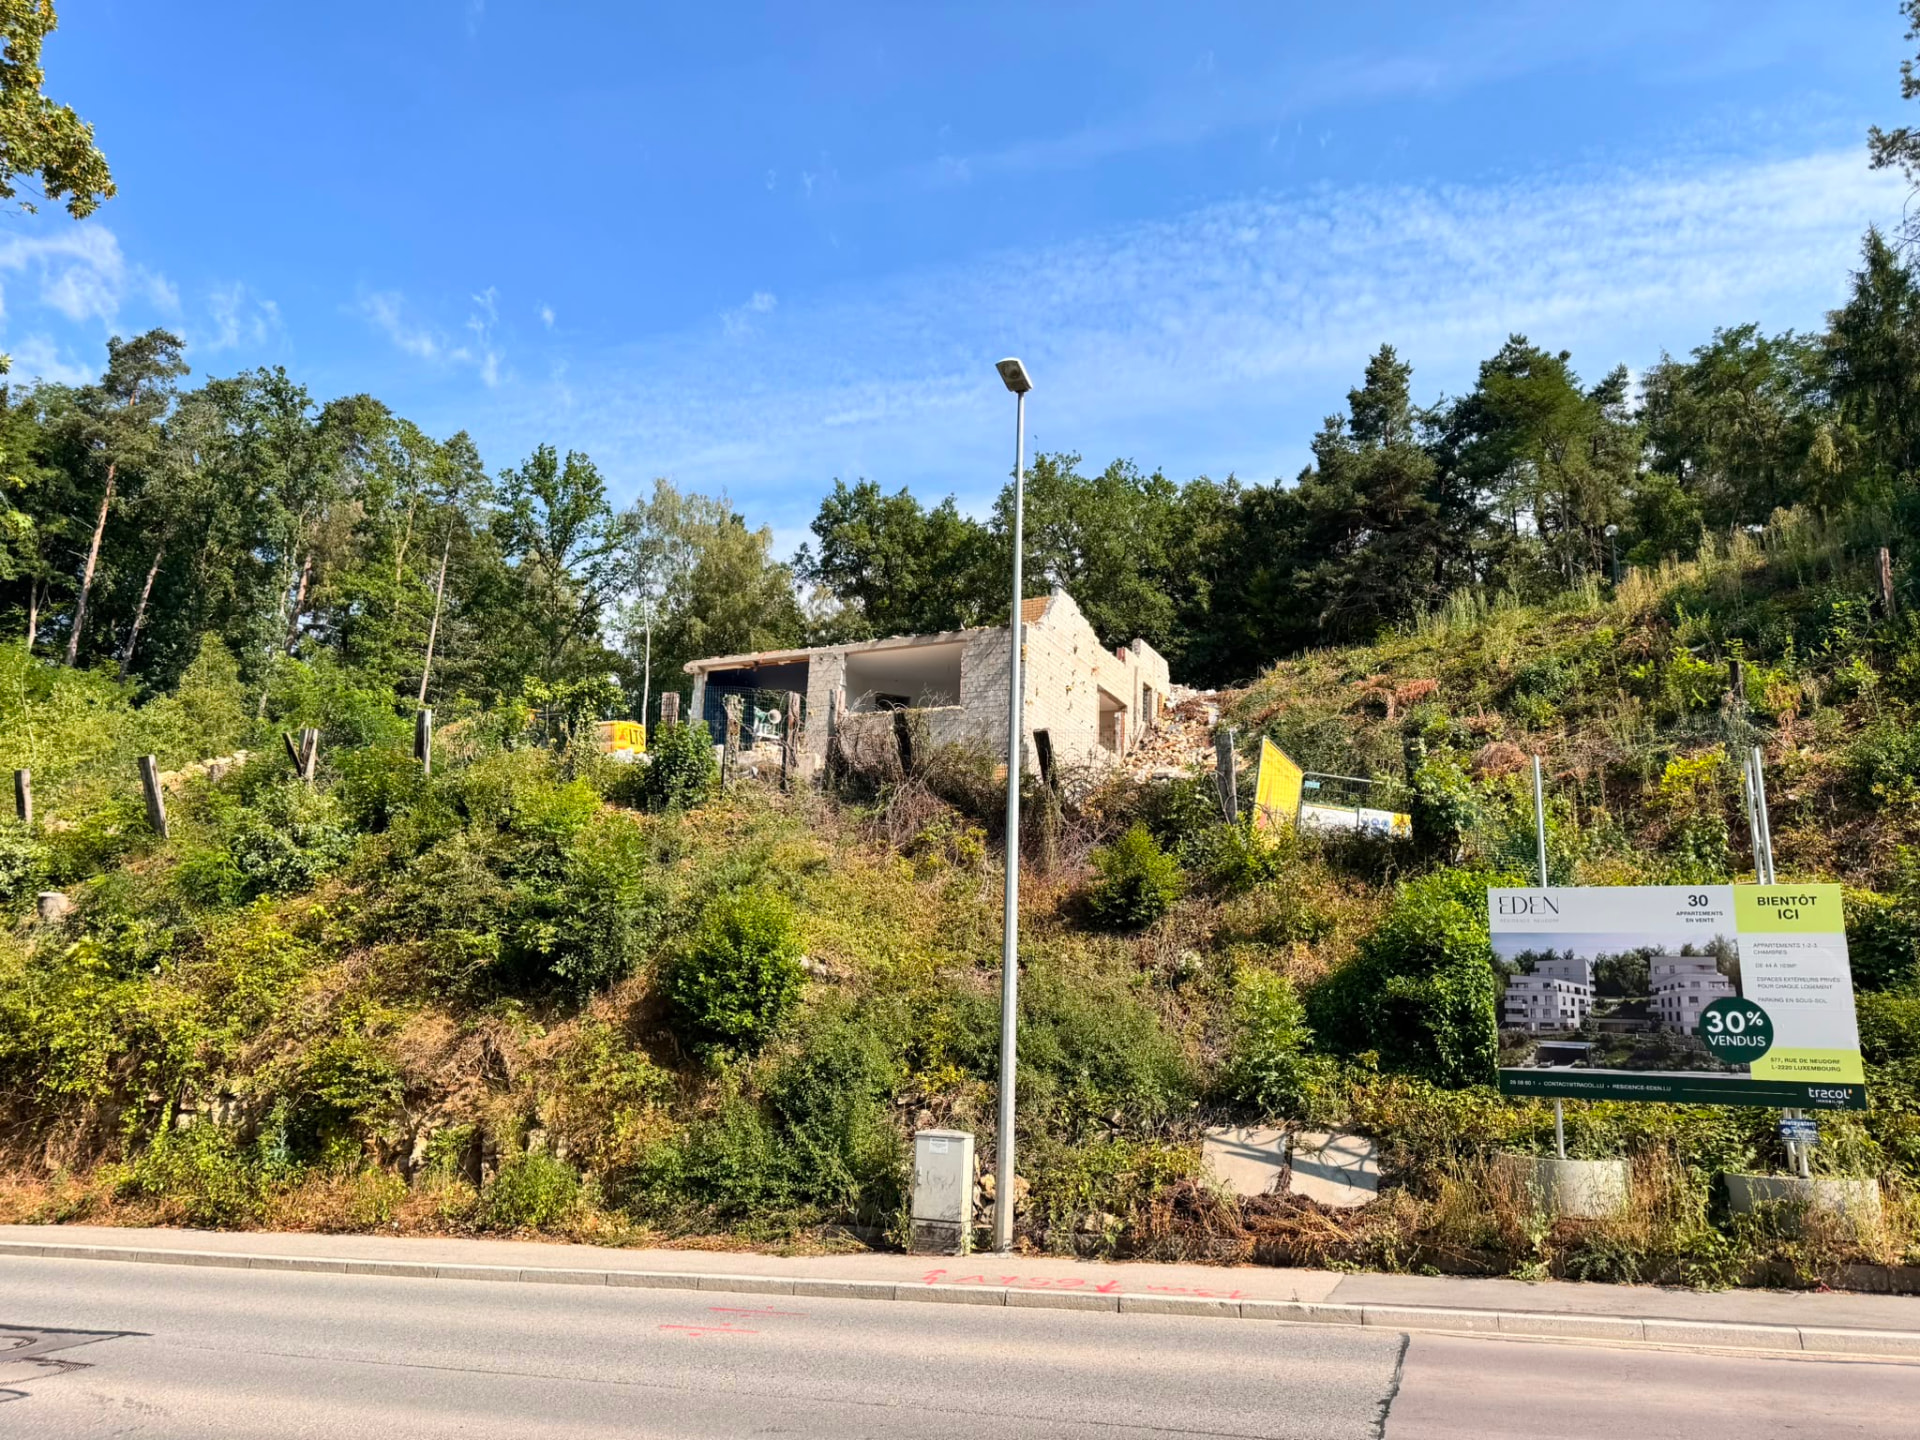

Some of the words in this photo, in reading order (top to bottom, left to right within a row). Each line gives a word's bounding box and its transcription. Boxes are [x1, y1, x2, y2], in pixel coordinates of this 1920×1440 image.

[1499, 895, 1559, 915] EDEN
[1688, 894, 1708, 907] 30
[1757, 894, 1817, 906] BIENTÔT
[1778, 909, 1799, 920] ICI
[1706, 1010, 1764, 1034] 30%
[1708, 1035, 1766, 1047] VENDUS
[1808, 1087, 1850, 1099] tracol
